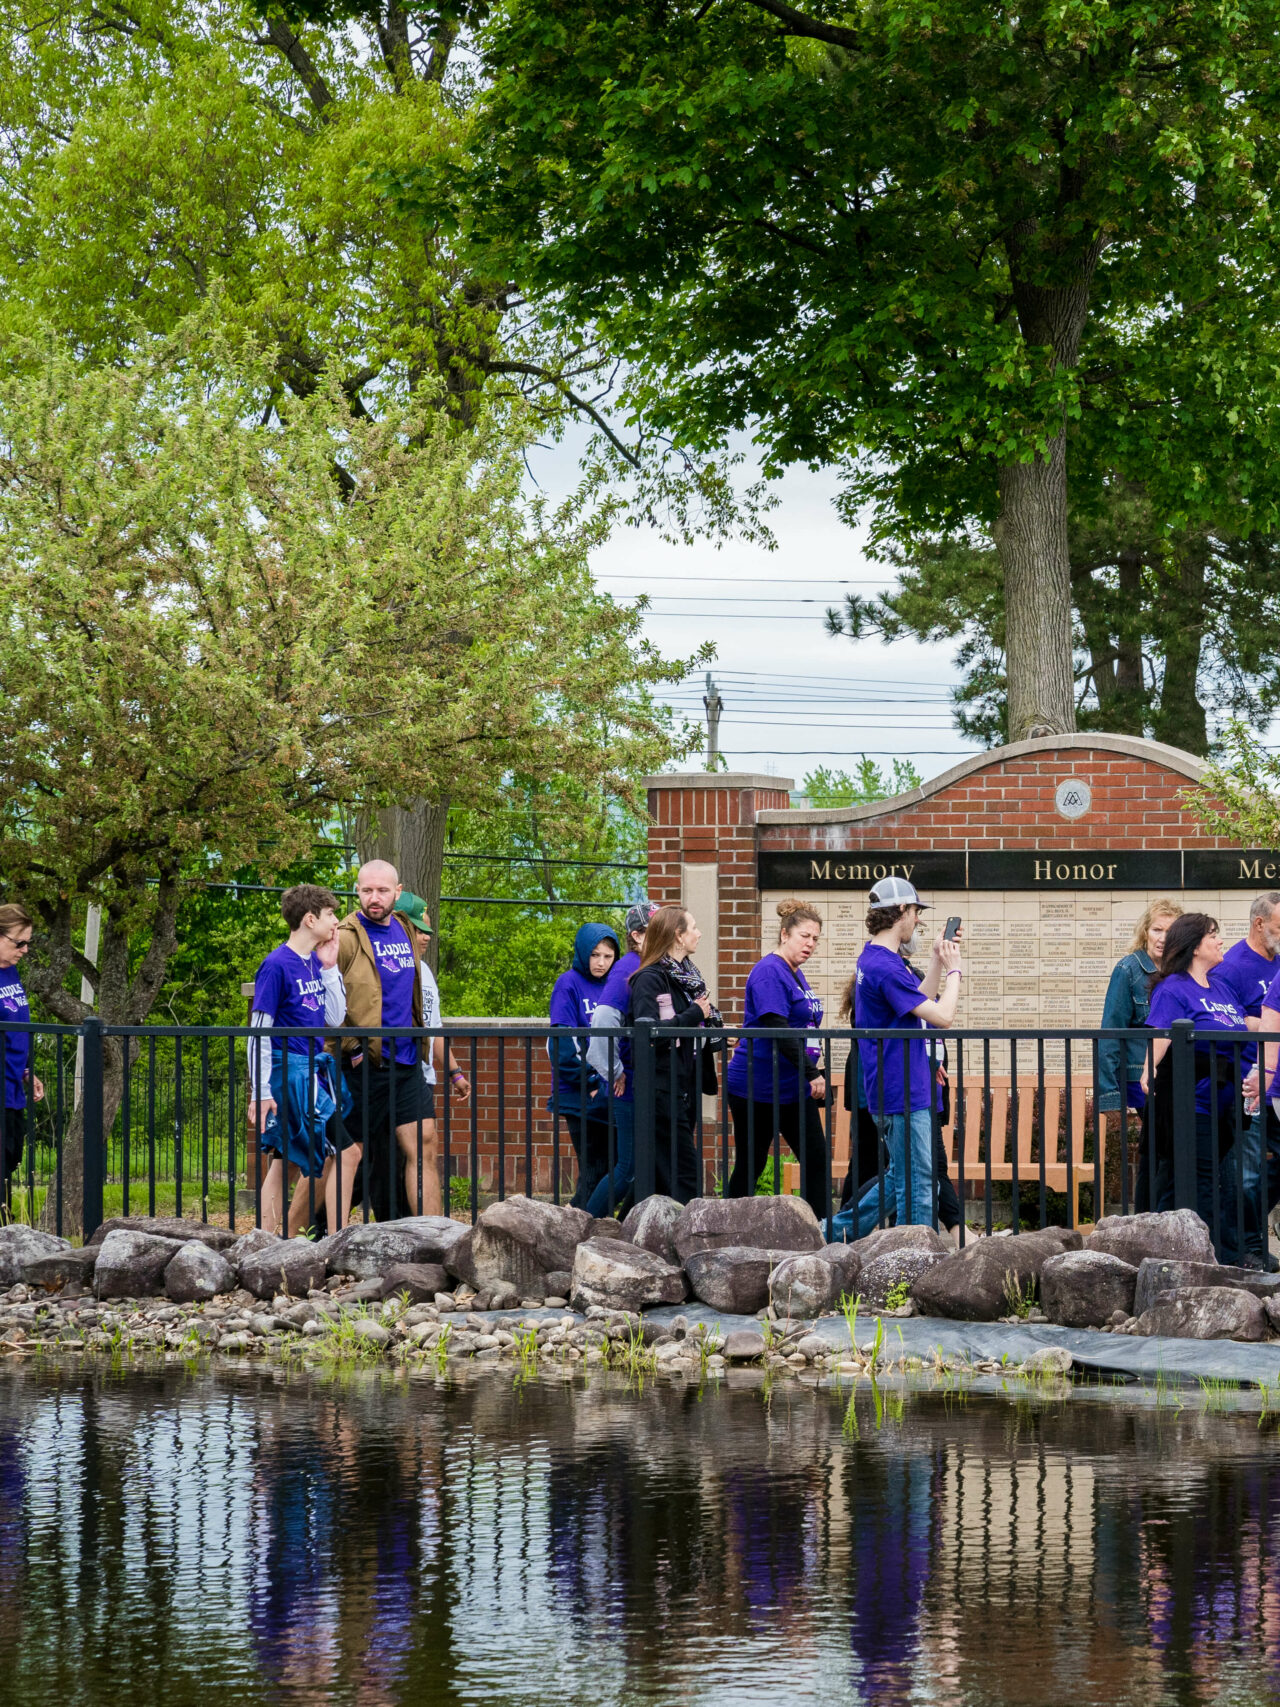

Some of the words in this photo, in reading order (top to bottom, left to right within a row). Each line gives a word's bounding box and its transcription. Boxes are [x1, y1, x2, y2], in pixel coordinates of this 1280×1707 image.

[810, 859, 915, 882] Memory
[1033, 859, 1118, 880] Honor
[373, 940, 411, 960] Lupus
